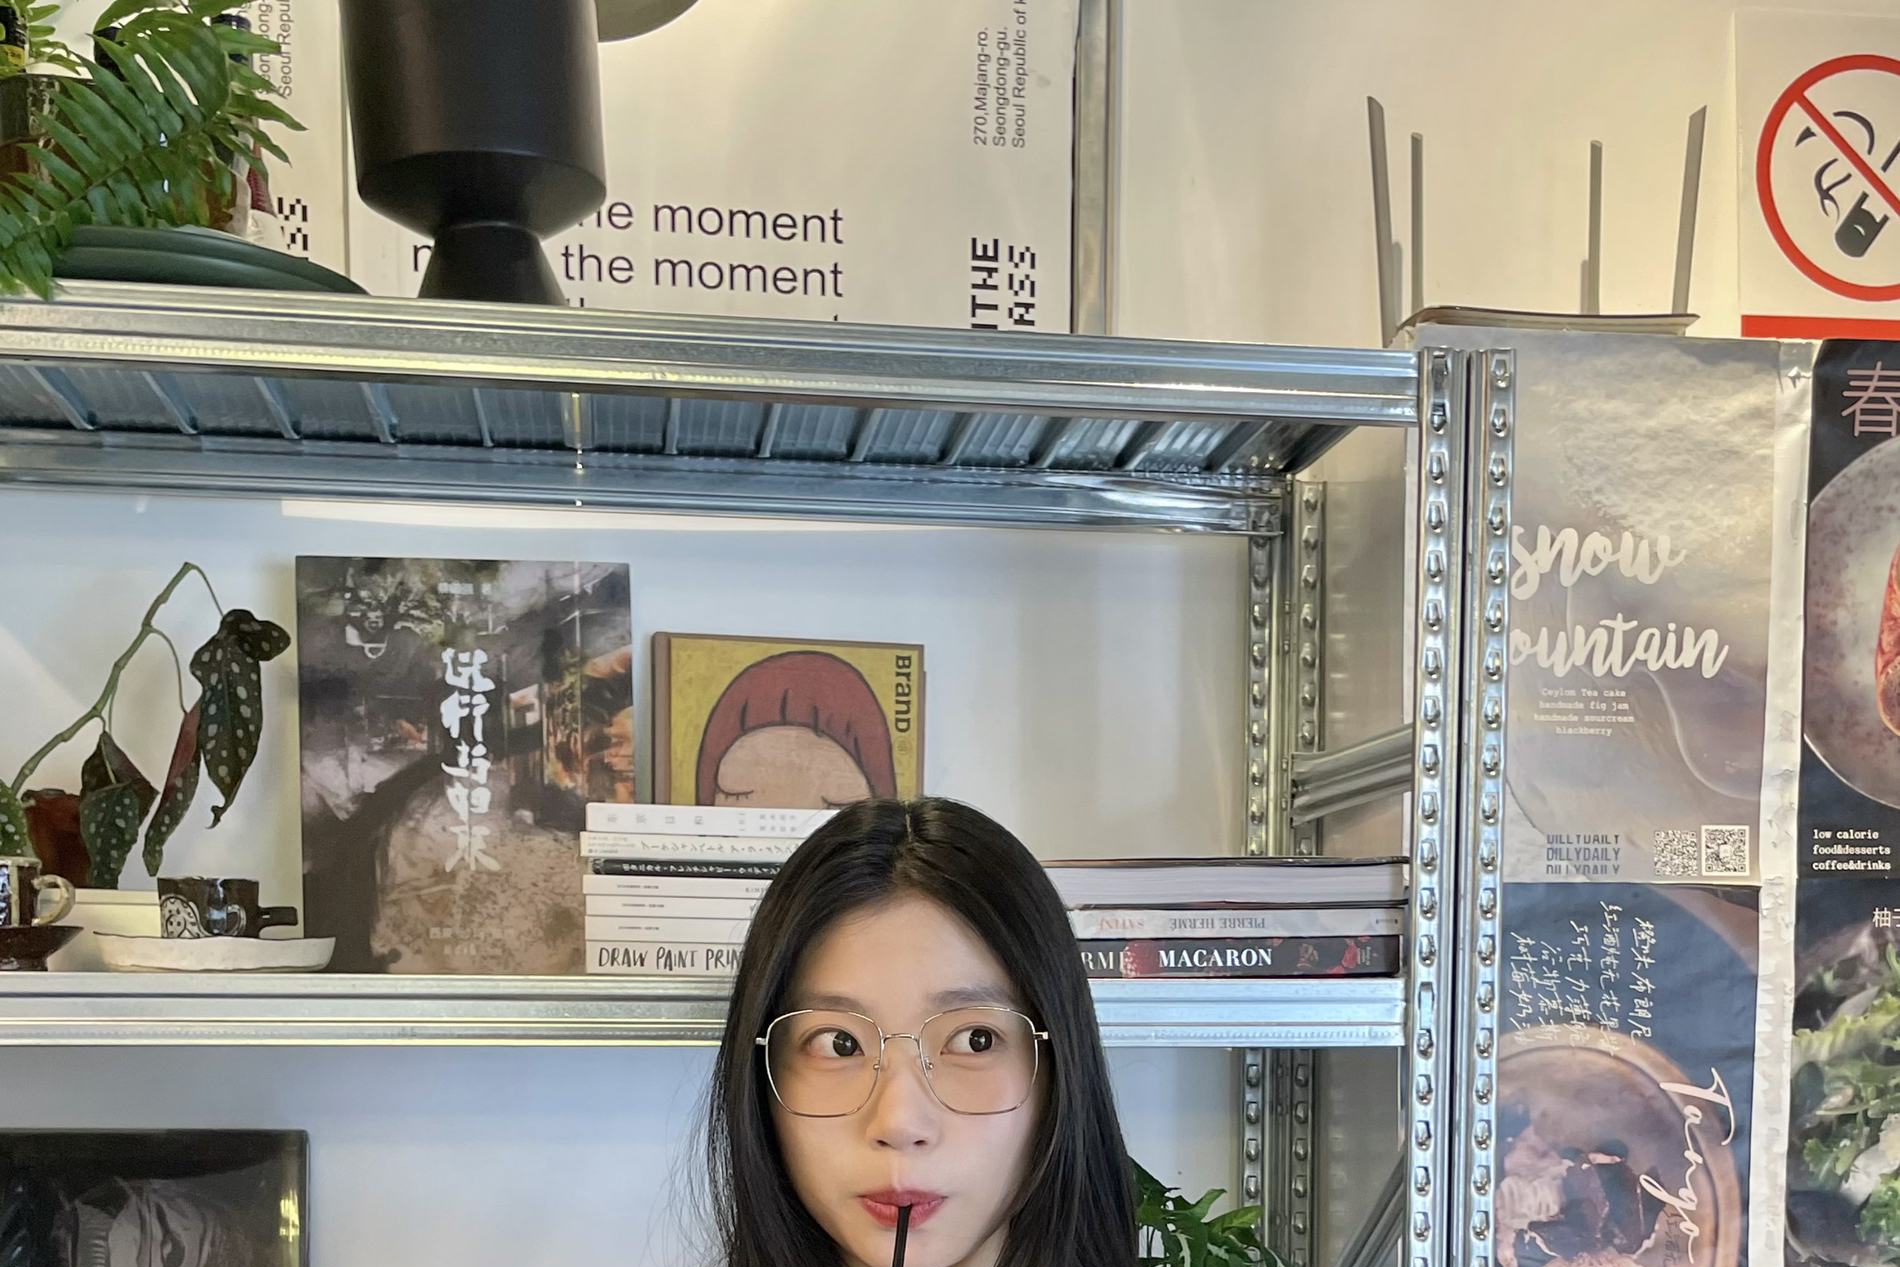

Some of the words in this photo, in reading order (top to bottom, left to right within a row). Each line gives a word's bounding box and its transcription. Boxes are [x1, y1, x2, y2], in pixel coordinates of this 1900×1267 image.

[1013, 8, 1027, 25] of
[1012, 29, 1029, 98] Republic
[277, 51, 292, 98] Seoul
[1011, 104, 1026, 148] Seoul
[654, 204, 843, 244] moment
[561, 244, 634, 283] the
[654, 258, 843, 297] moment
[1841, 361, 1900, 437] 春
[1511, 525, 1688, 600] snow
[1509, 612, 1730, 678] ountain
[1541, 688, 1577, 698] Ceylon
[1580, 688, 1599, 697] Tea
[1603, 689, 1627, 697] cake
[1538, 700, 1585, 710] handmade
[1589, 701, 1607, 711] fig
[1612, 701, 1630, 711] jam
[1533, 713, 1579, 722] handmade
[1555, 726, 1613, 737] blackberry
[1812, 829, 1833, 840] low
[1836, 829, 1880, 840] calorie
[1546, 847, 1621, 862] DILLYDAILY
[1812, 844, 1891, 855] food&desserts
[1812, 860, 1892, 871] coffee&drinks
[1219, 917, 1266, 929] PIERRE
[598, 946, 648, 968] DRAW
[656, 946, 698, 971] PAINT
[1158, 948, 1273, 968] MACARON
